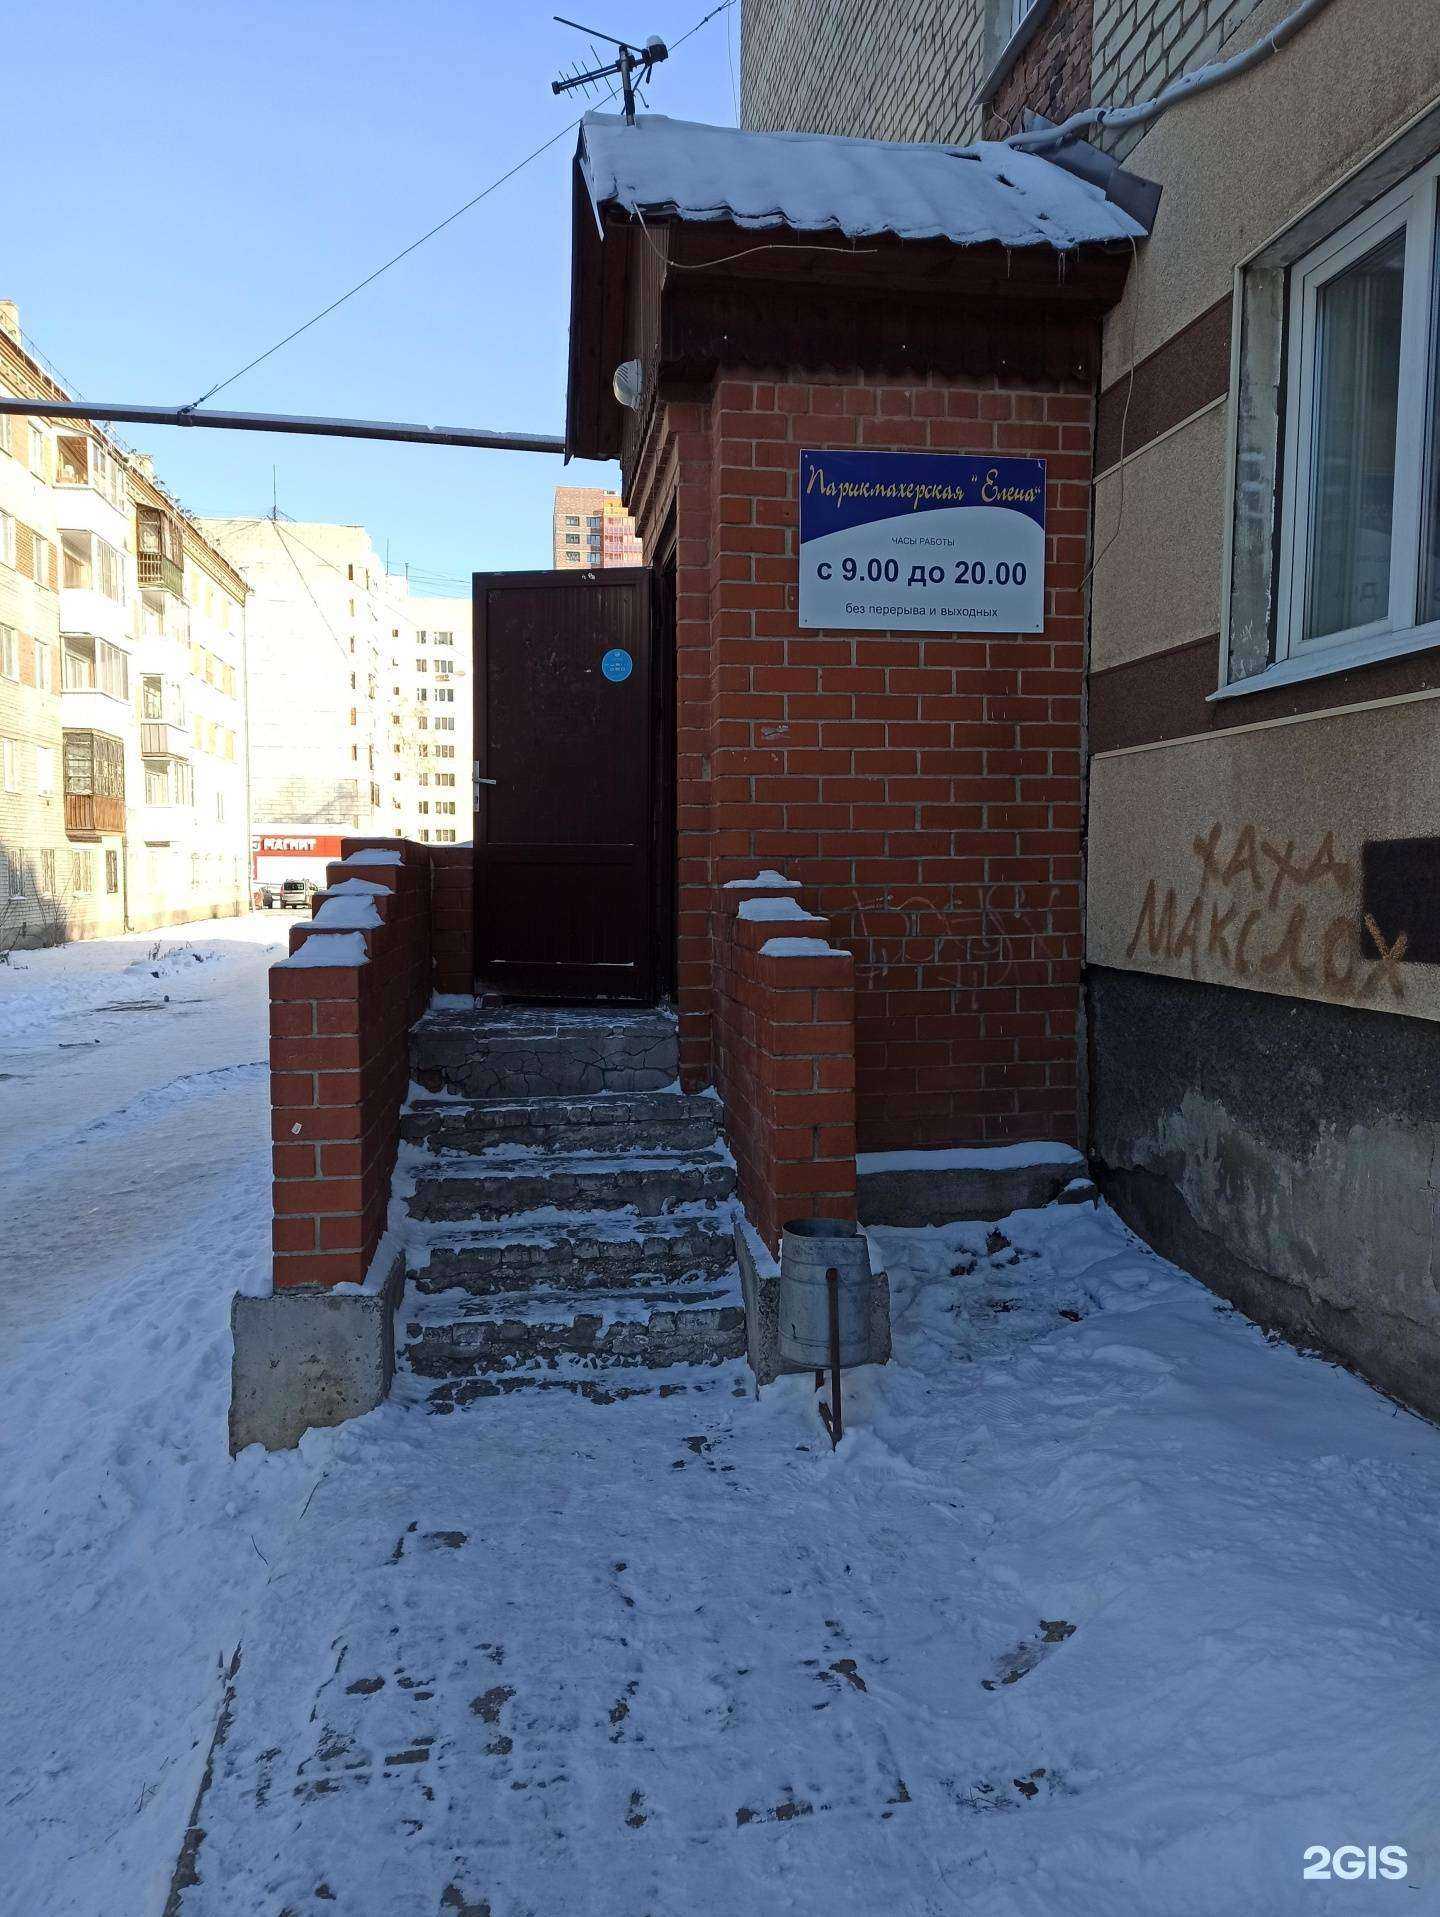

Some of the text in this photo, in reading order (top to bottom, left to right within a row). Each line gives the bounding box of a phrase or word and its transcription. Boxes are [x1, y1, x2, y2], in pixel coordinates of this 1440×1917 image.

[806, 464, 965, 509] Парикмахерская
[891, 537, 955, 547] ЧАСЫ РАБОТЫ
[816, 557, 1027, 587] с 9.00 до 20.00
[845, 602, 998, 619] без перерыва и выходных
